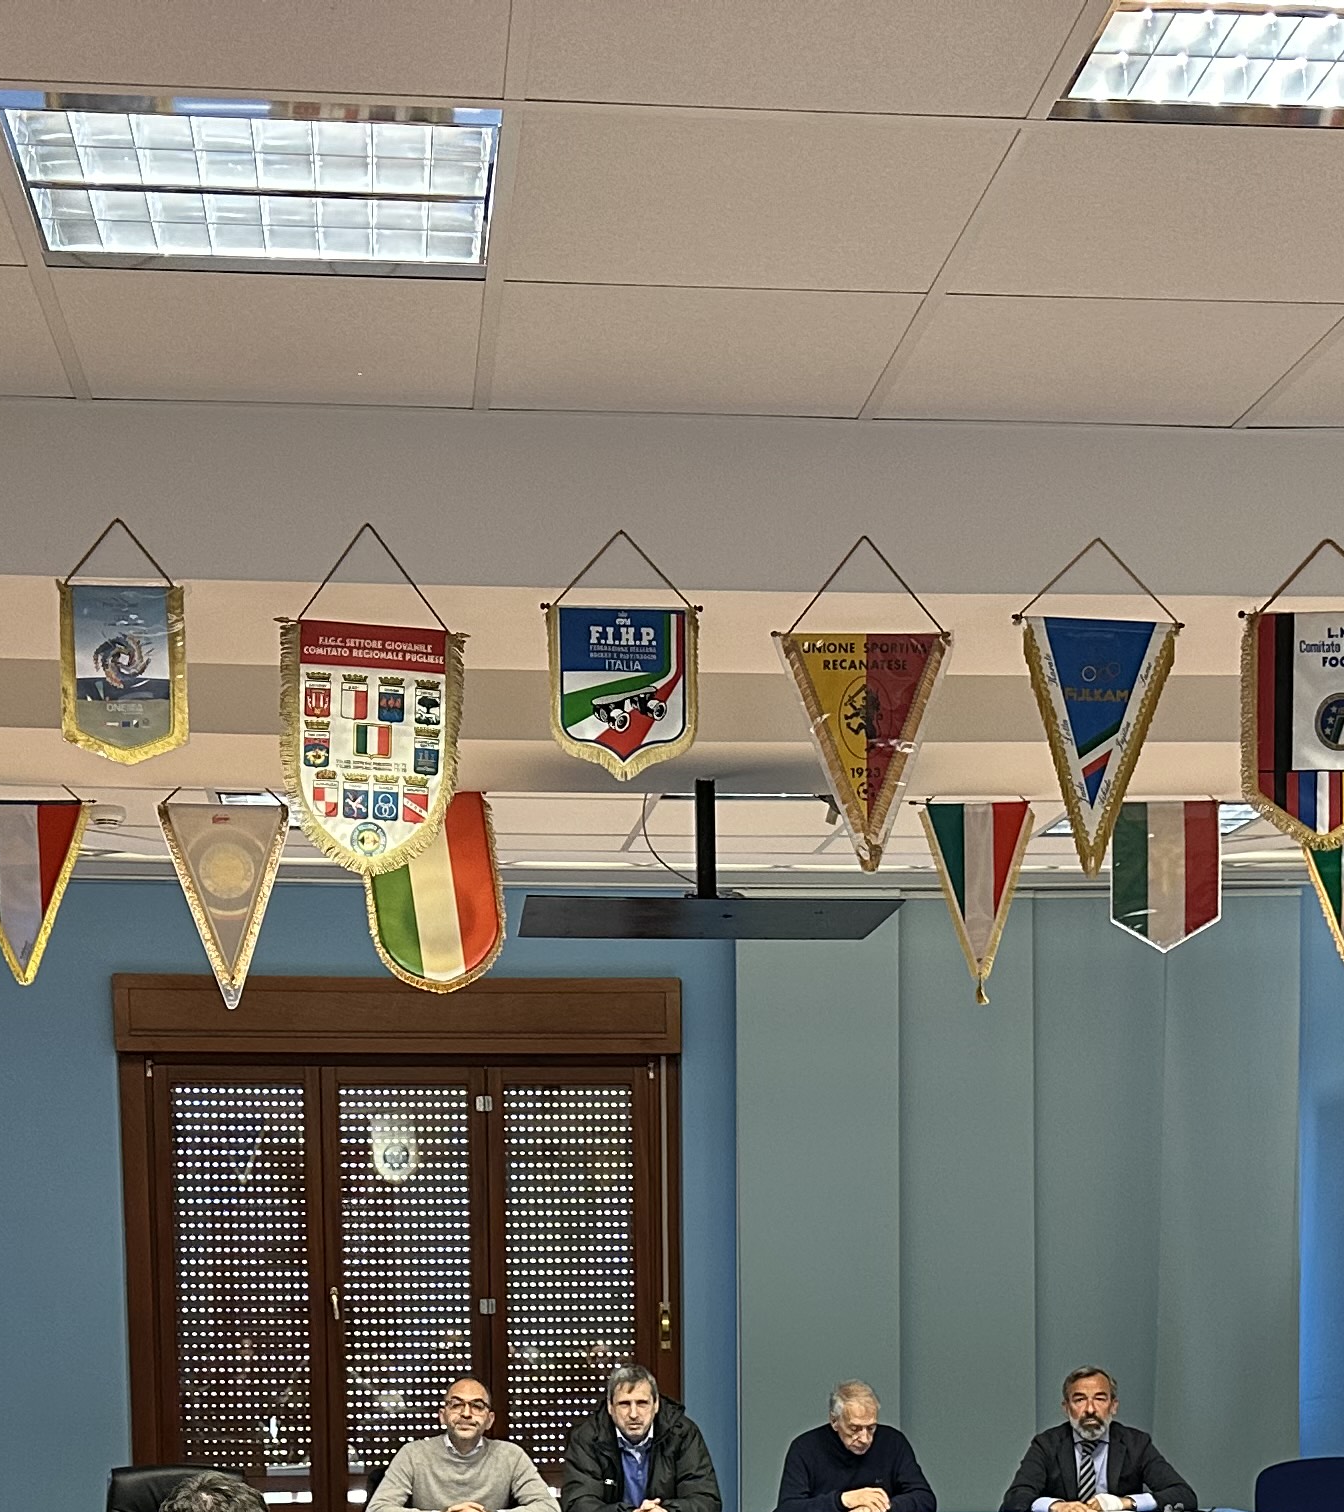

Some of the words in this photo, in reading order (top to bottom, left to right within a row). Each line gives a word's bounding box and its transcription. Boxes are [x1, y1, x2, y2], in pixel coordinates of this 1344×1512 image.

[589, 625, 657, 646] F.I.H.P.
[345, 638, 383, 649] SETTORE
[385, 640, 433, 653] GIOVANILE
[802, 641, 856, 654] UNIONE
[863, 642, 929, 655] SPORTIVA
[1299, 640, 1341, 653] Comitato
[303, 645, 350, 657] COMITATO
[352, 648, 403, 661] REGIONALE
[405, 653, 445, 665] PUGLIESE
[605, 659, 642, 671] ITALIA
[822, 659, 908, 671] RECANATESE
